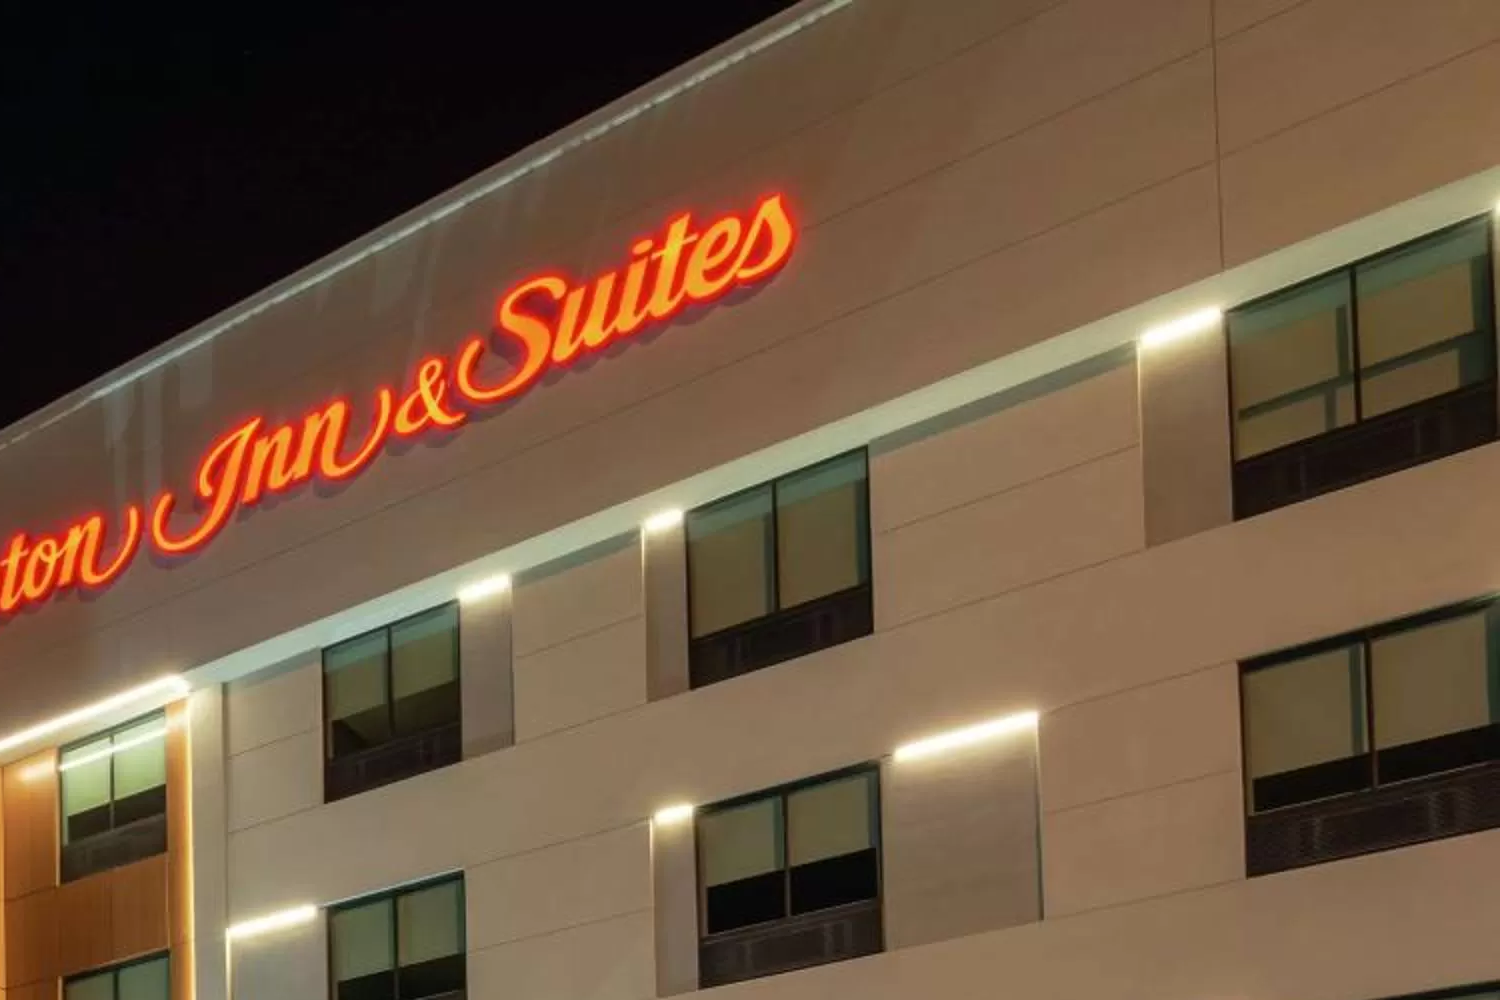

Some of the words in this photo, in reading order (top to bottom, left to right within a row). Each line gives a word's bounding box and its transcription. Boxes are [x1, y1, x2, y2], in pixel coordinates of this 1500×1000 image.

[151, 389, 391, 552] Inn
[392, 356, 465, 437] &
[456, 193, 794, 402] Suites
